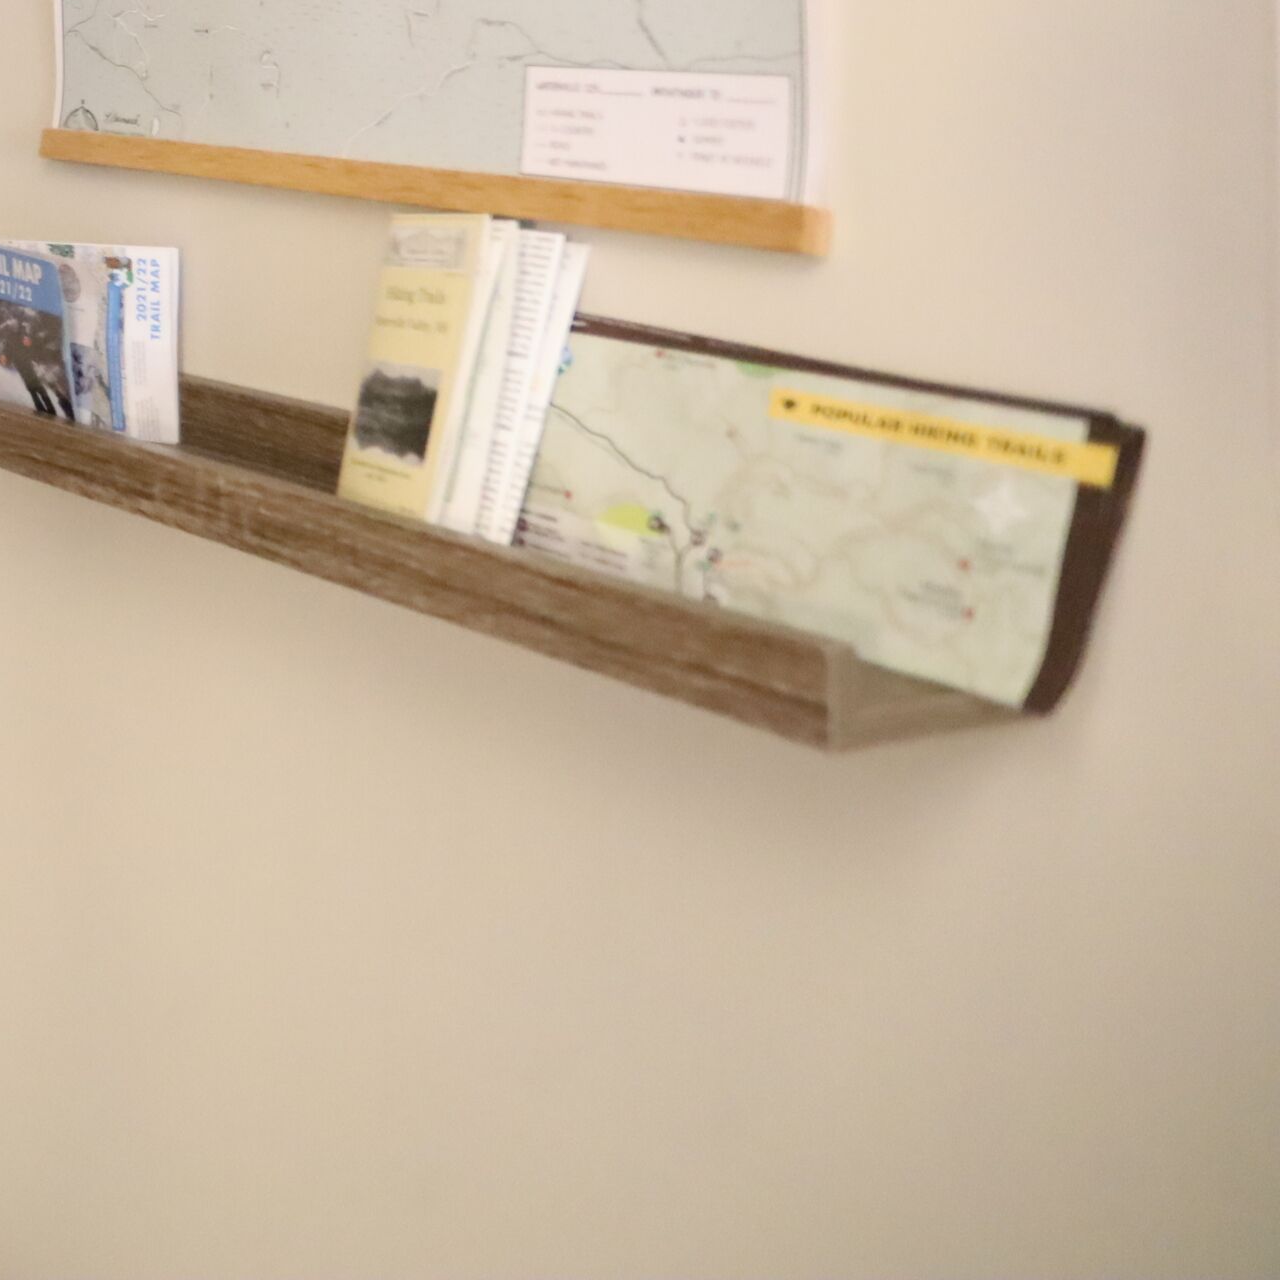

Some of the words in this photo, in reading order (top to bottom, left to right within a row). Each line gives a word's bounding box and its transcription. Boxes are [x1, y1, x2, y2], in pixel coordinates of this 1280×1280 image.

[12, 257, 43, 285] MAP
[135, 258, 148, 321] 2021/22
[150, 258, 161, 293] MAP
[150, 301, 161, 340] TRAIL
